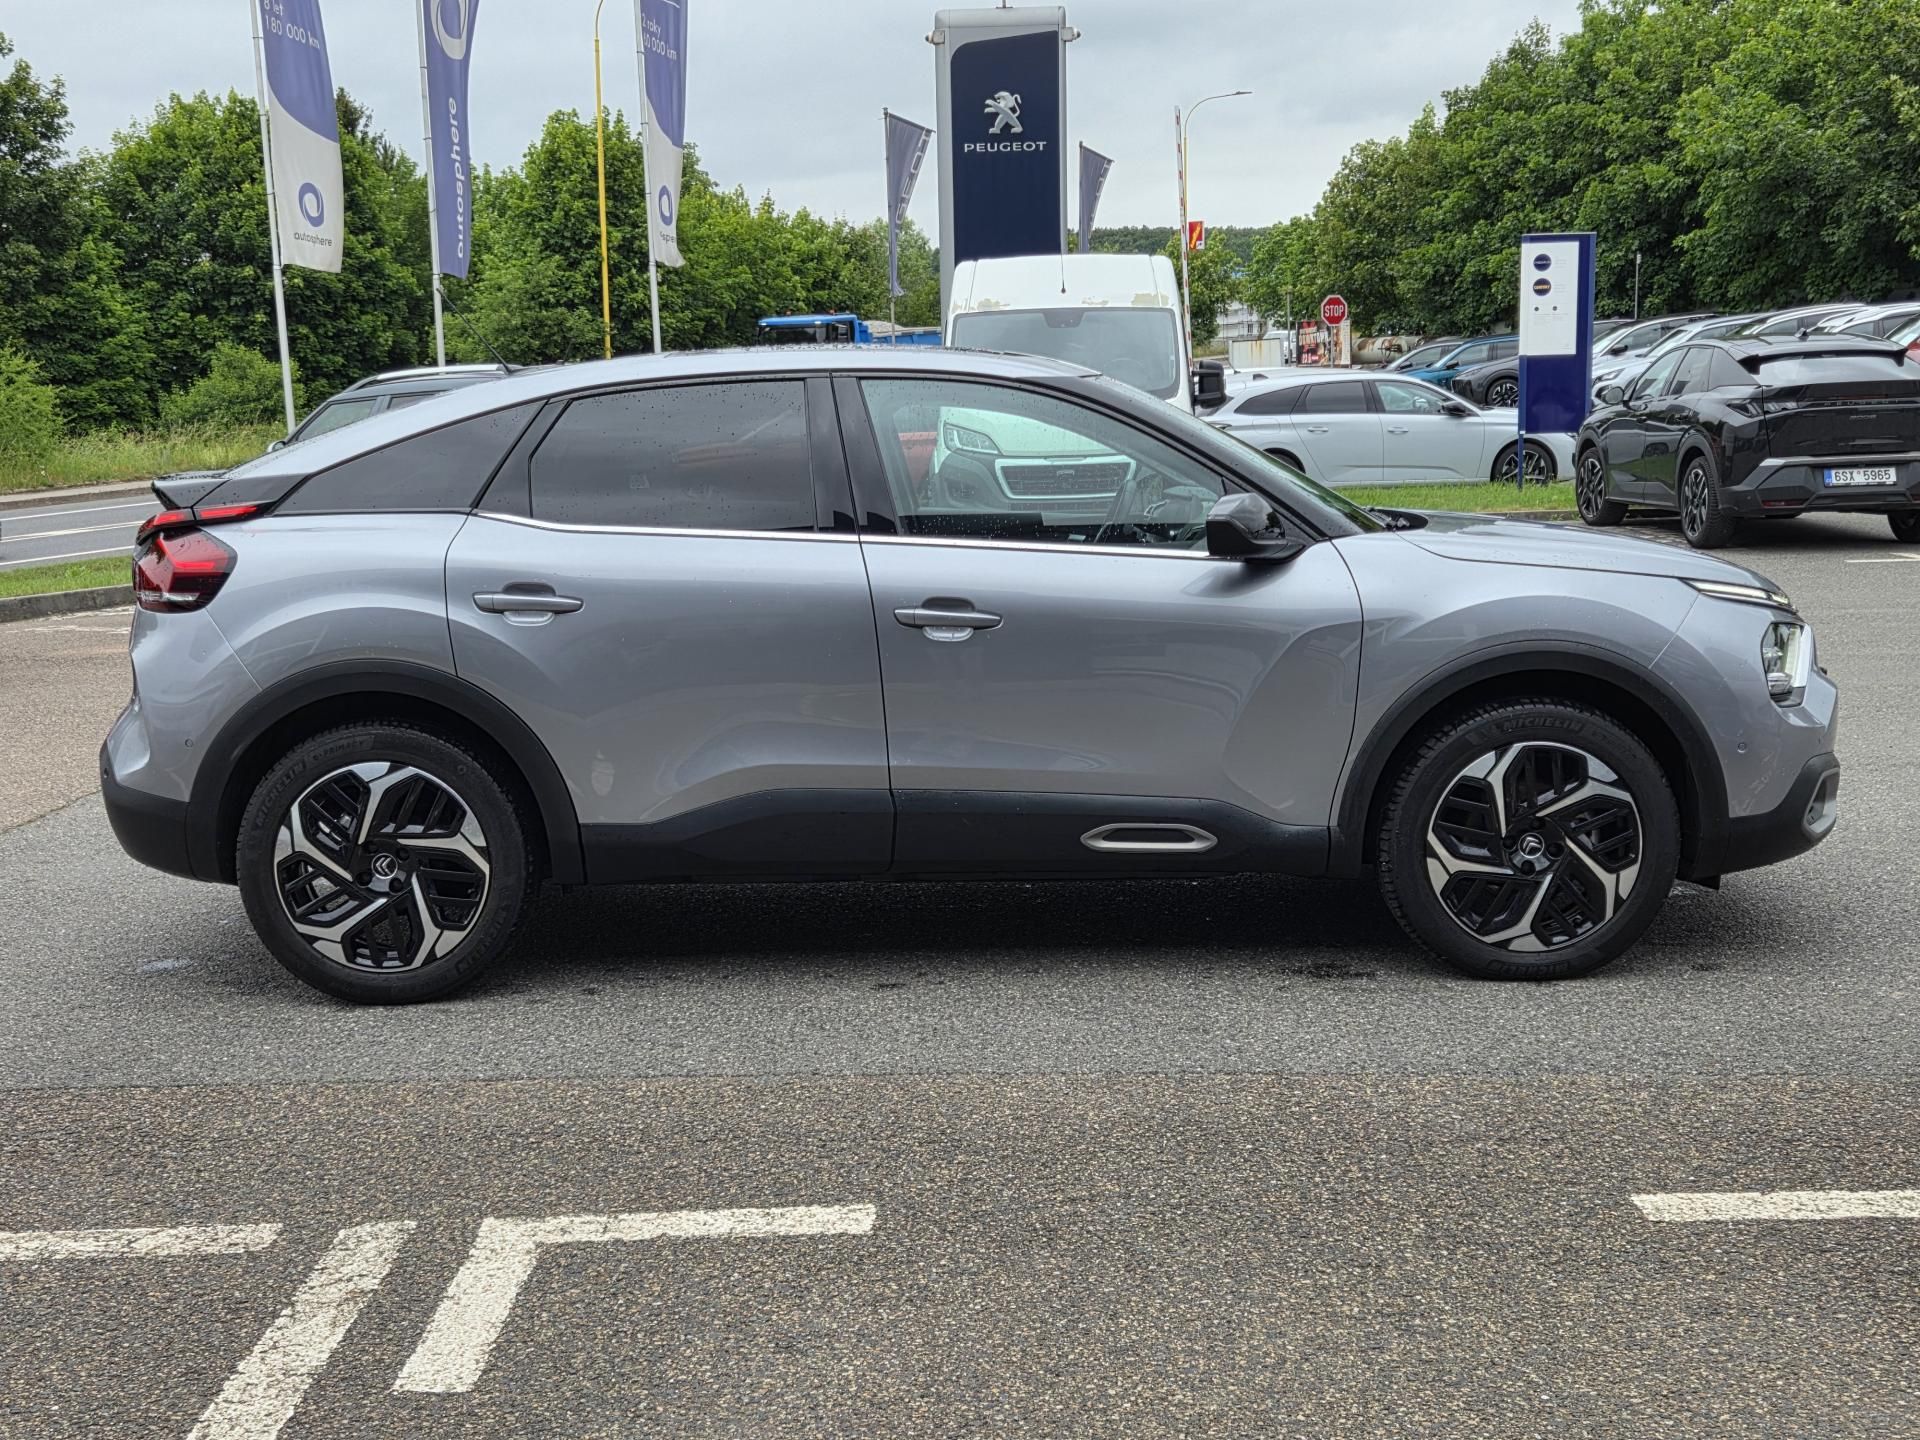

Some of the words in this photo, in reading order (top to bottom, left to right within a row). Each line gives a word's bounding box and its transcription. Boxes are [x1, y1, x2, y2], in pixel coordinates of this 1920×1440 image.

[265, 14, 282, 35] 180
[286, 23, 306, 44] 000
[308, 31, 320, 49] km
[647, 18, 661, 39] roky
[651, 37, 665, 55] 000
[666, 43, 677, 60] km
[964, 141, 1047, 153] PEUGEOT
[448, 97, 465, 259] autosphere
[293, 231, 333, 247] autosphere
[1324, 305, 1344, 317] STOP
[1834, 470, 1855, 482] 6SX
[1863, 469, 1891, 481] 5965
[1502, 716, 1584, 734] MICHELIN
[255, 758, 306, 828] MICHELIN
